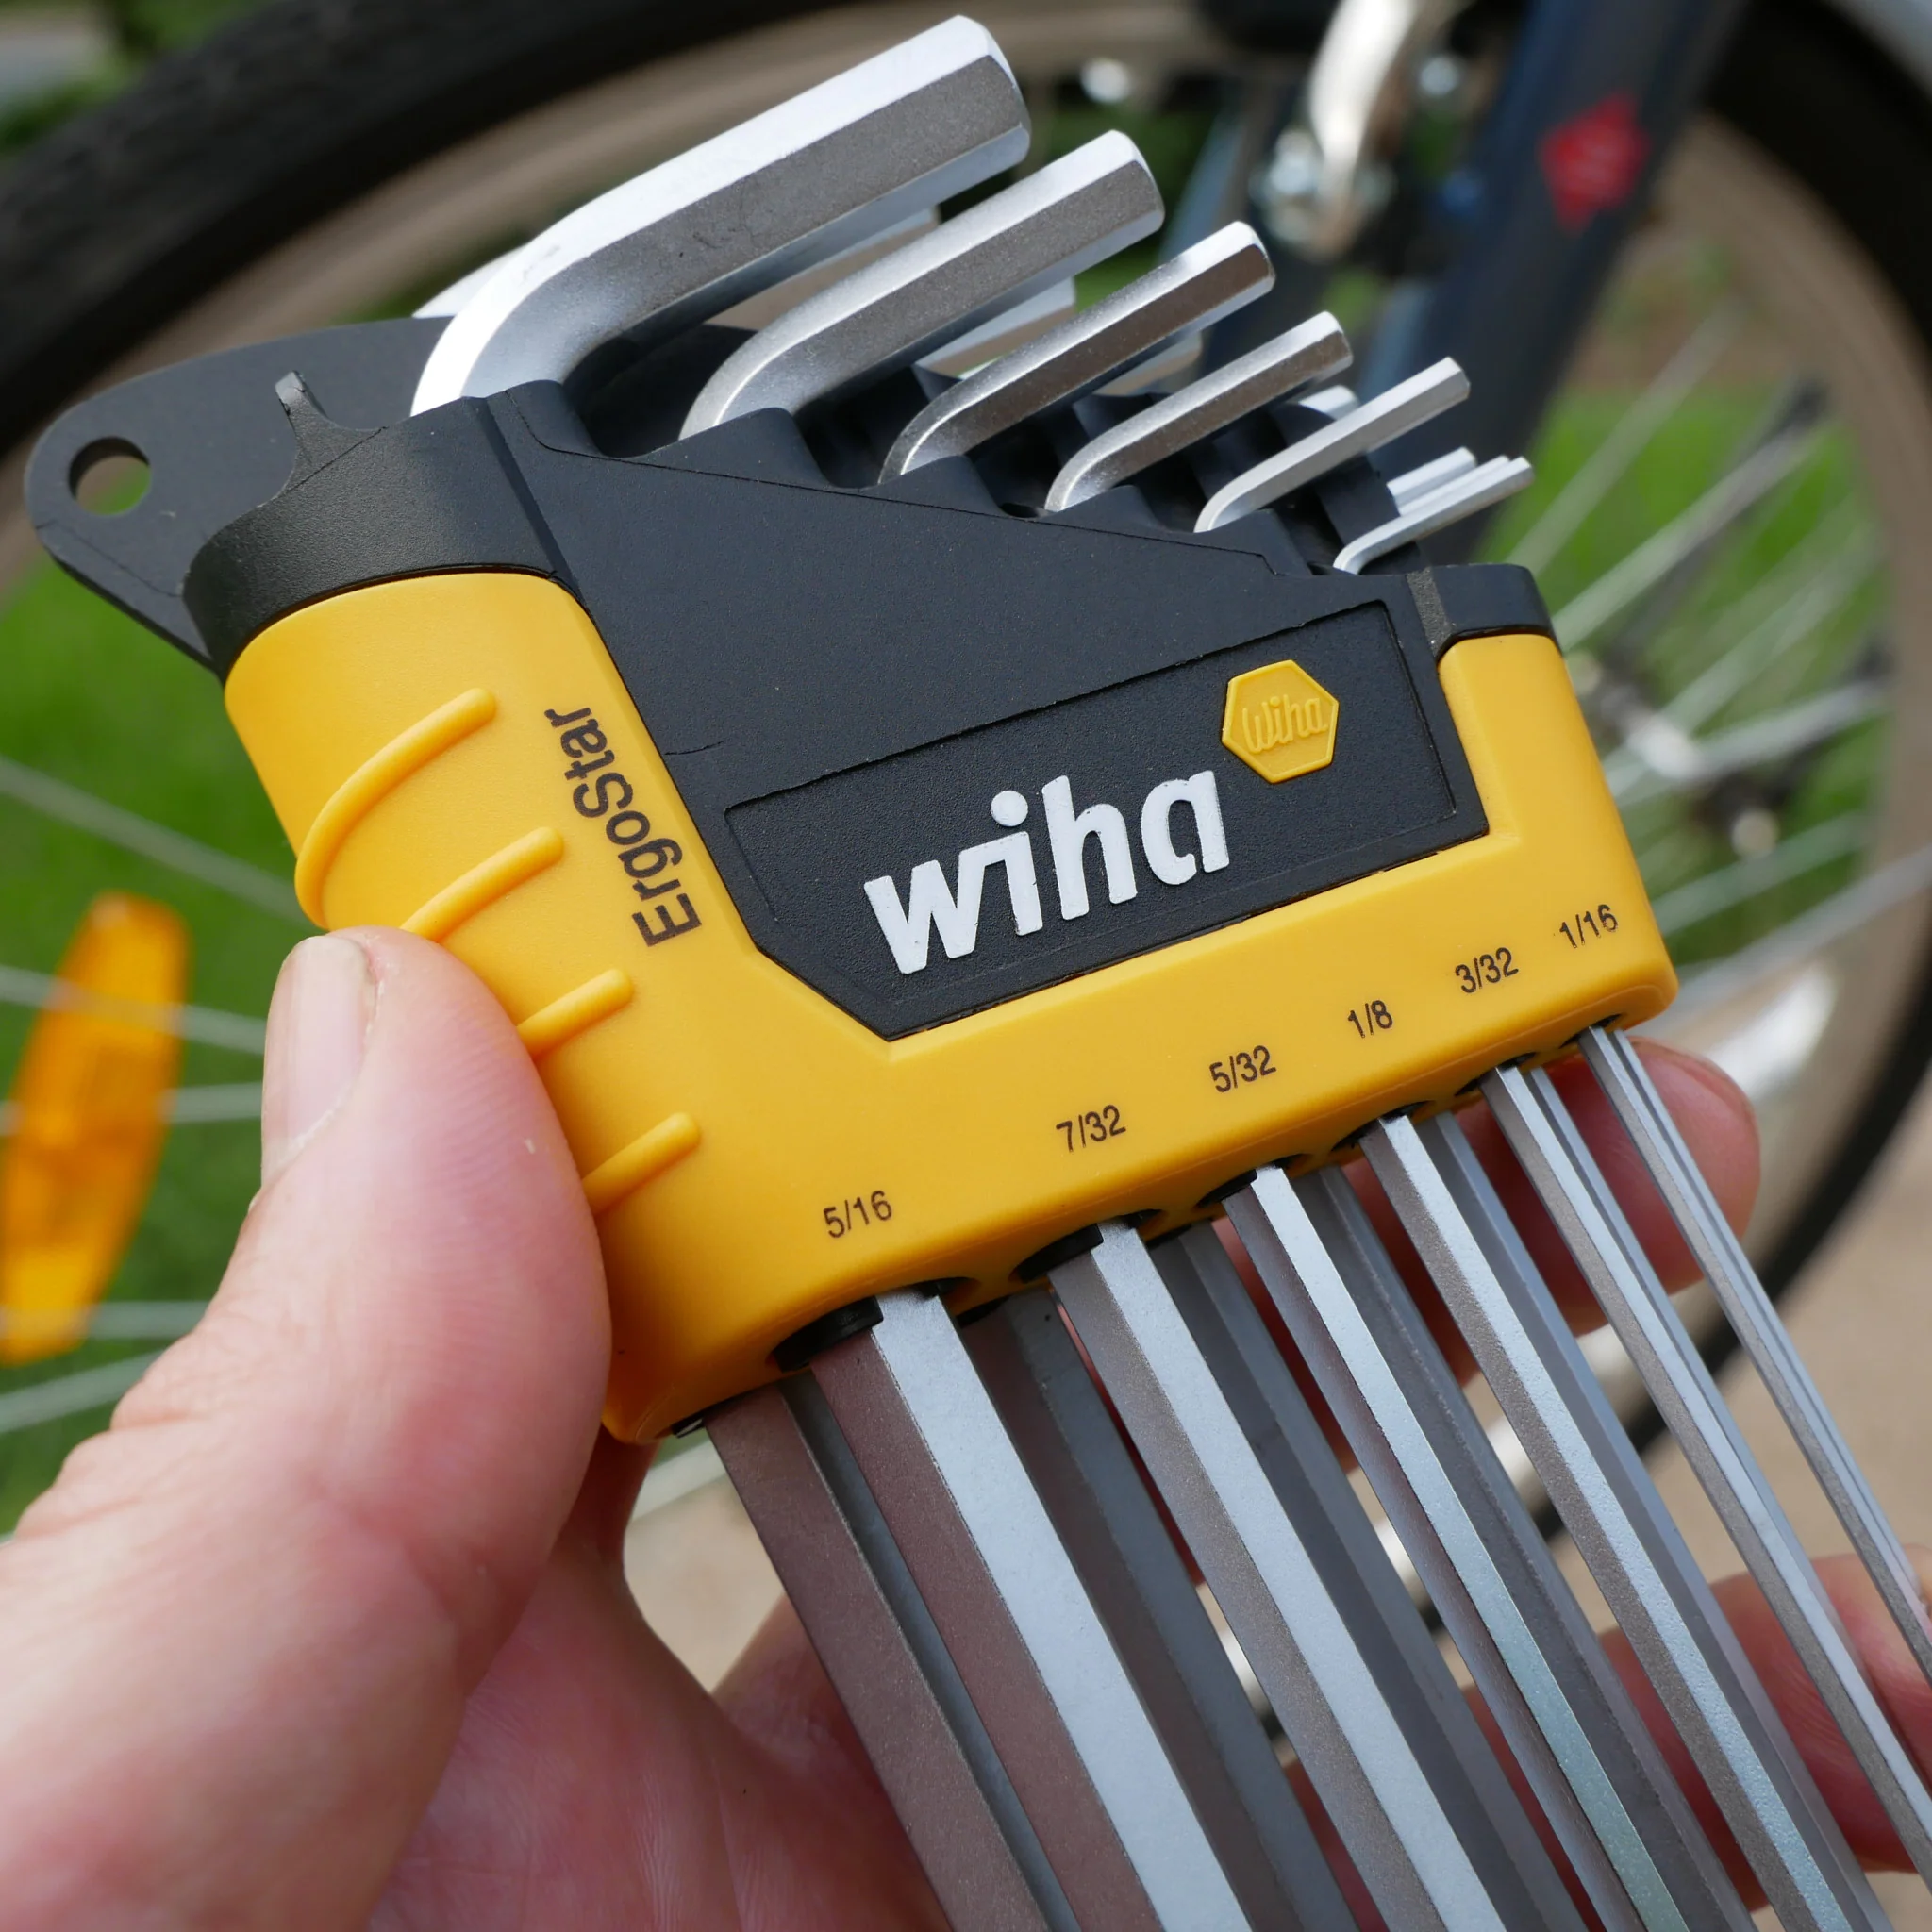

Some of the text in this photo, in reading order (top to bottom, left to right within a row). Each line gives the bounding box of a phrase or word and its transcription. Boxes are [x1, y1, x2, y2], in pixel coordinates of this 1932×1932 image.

[543, 707, 703, 948] ErgoStar
[863, 769, 1230, 975] wiha
[1559, 903, 1619, 949] 1/16
[1454, 946, 1520, 994] 3/32
[1347, 999, 1394, 1039] 1/8
[1208, 1044, 1277, 1093] 5/32
[1055, 1104, 1127, 1153] 7/32
[823, 1190, 893, 1239] 5/16
